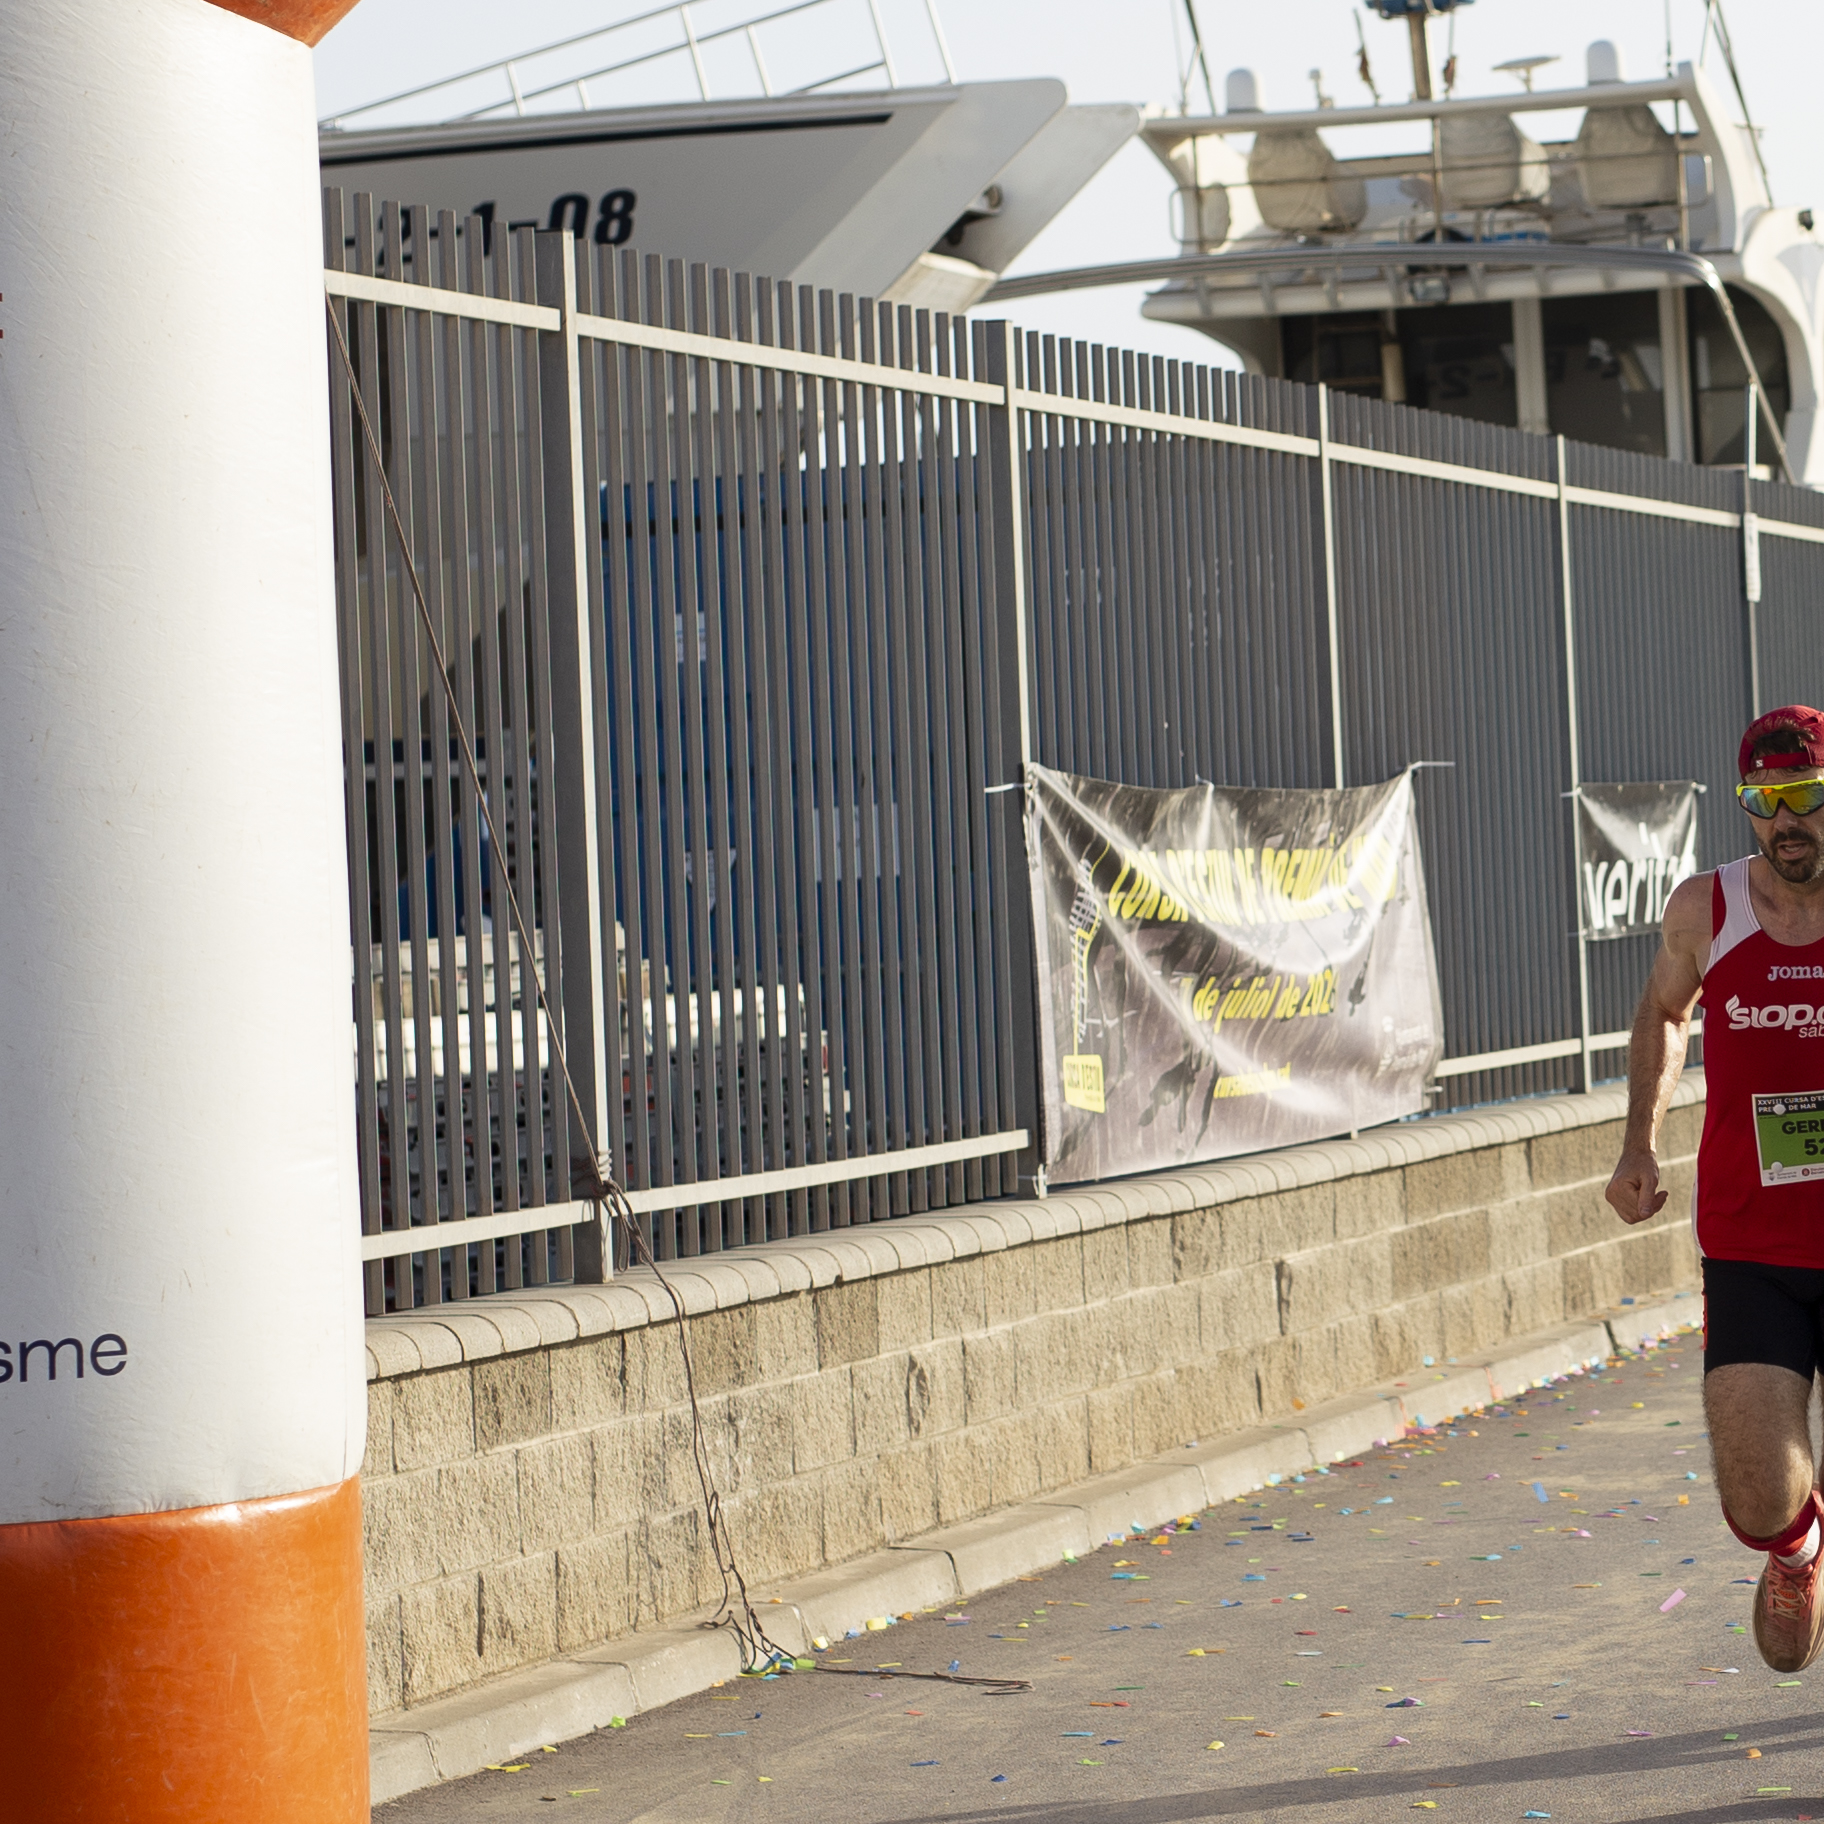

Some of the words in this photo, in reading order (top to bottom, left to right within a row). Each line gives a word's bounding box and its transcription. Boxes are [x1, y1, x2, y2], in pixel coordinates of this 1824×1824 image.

[1193, 976, 1220, 1022] de
[1213, 976, 1281, 1034] juliol
[1274, 973, 1301, 1020] de
[1784, 1096, 1809, 1105] CURSA
